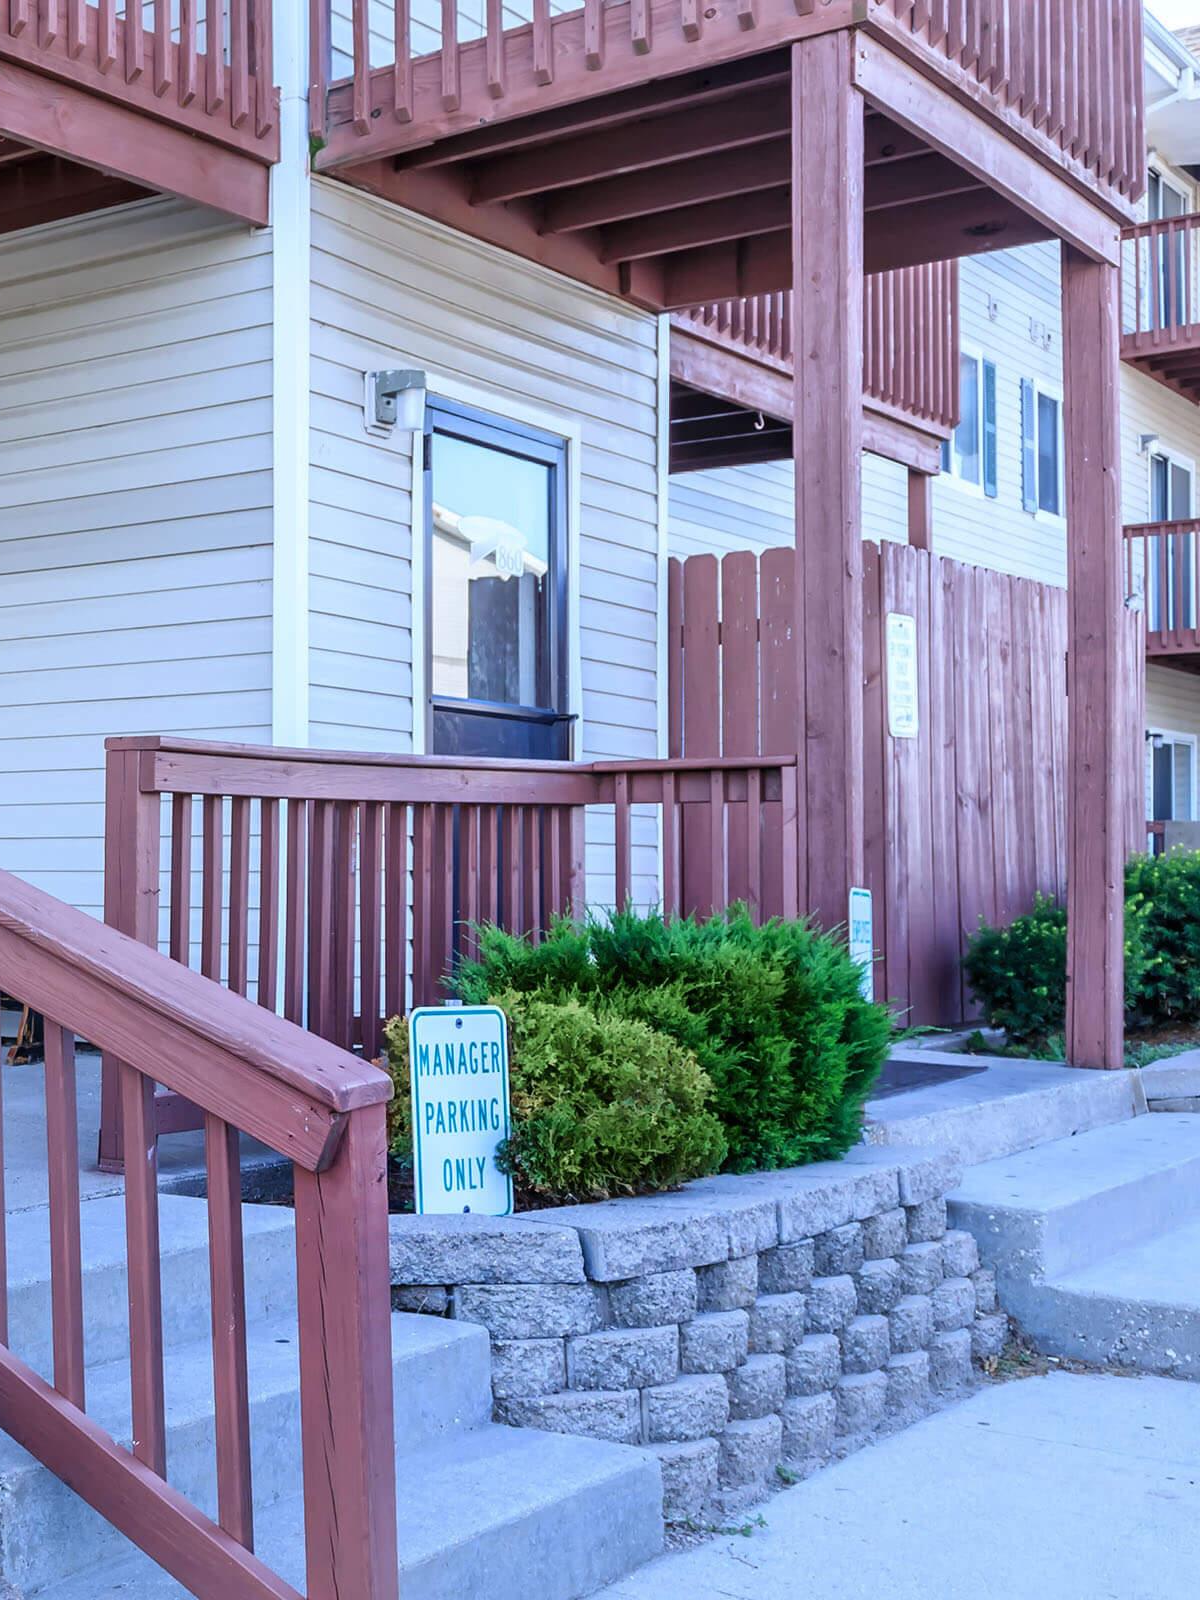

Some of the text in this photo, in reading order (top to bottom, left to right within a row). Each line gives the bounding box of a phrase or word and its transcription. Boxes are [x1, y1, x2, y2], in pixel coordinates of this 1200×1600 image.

[418, 1041, 501, 1077] MANAGER
[425, 1097, 500, 1135] PARKING
[442, 1156, 486, 1192] ONLY
